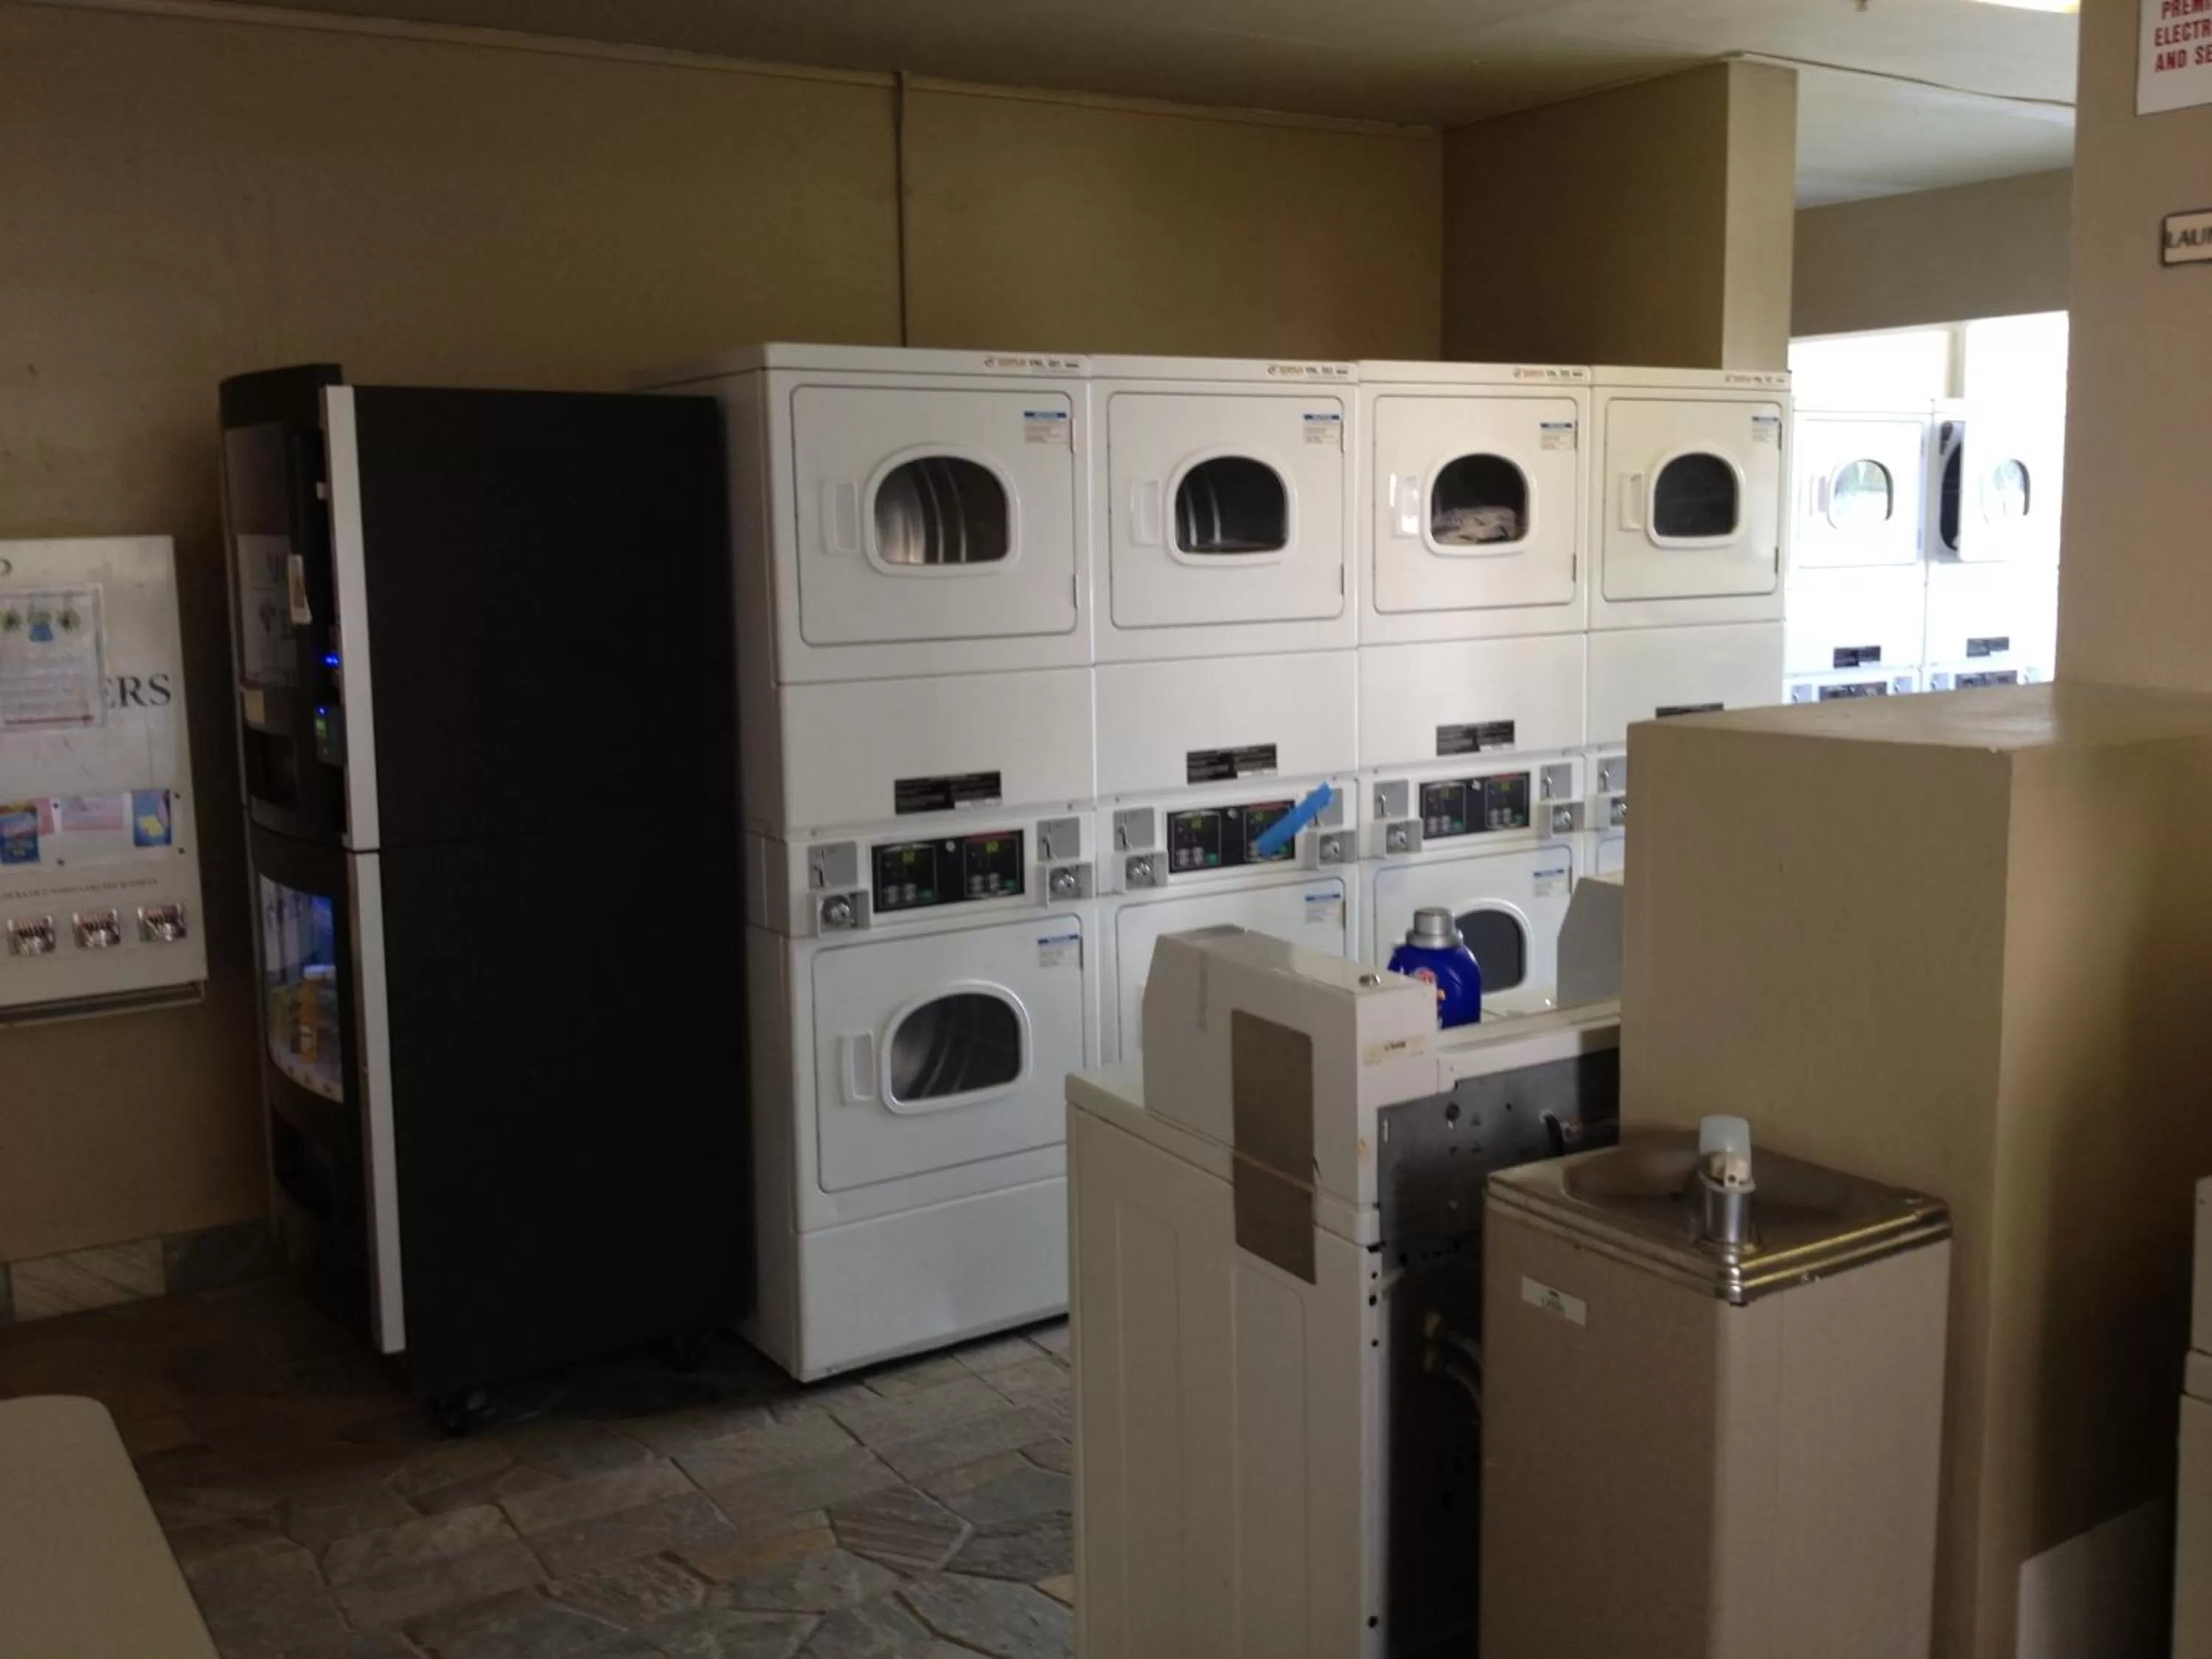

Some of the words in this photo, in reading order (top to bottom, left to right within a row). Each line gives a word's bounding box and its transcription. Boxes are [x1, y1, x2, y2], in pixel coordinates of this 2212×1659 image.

[2155, 18, 2212, 46] ELECTR
[2155, 49, 2187, 72] AND
[2194, 44, 2212, 66] SE
[106, 673, 171, 708] RS
